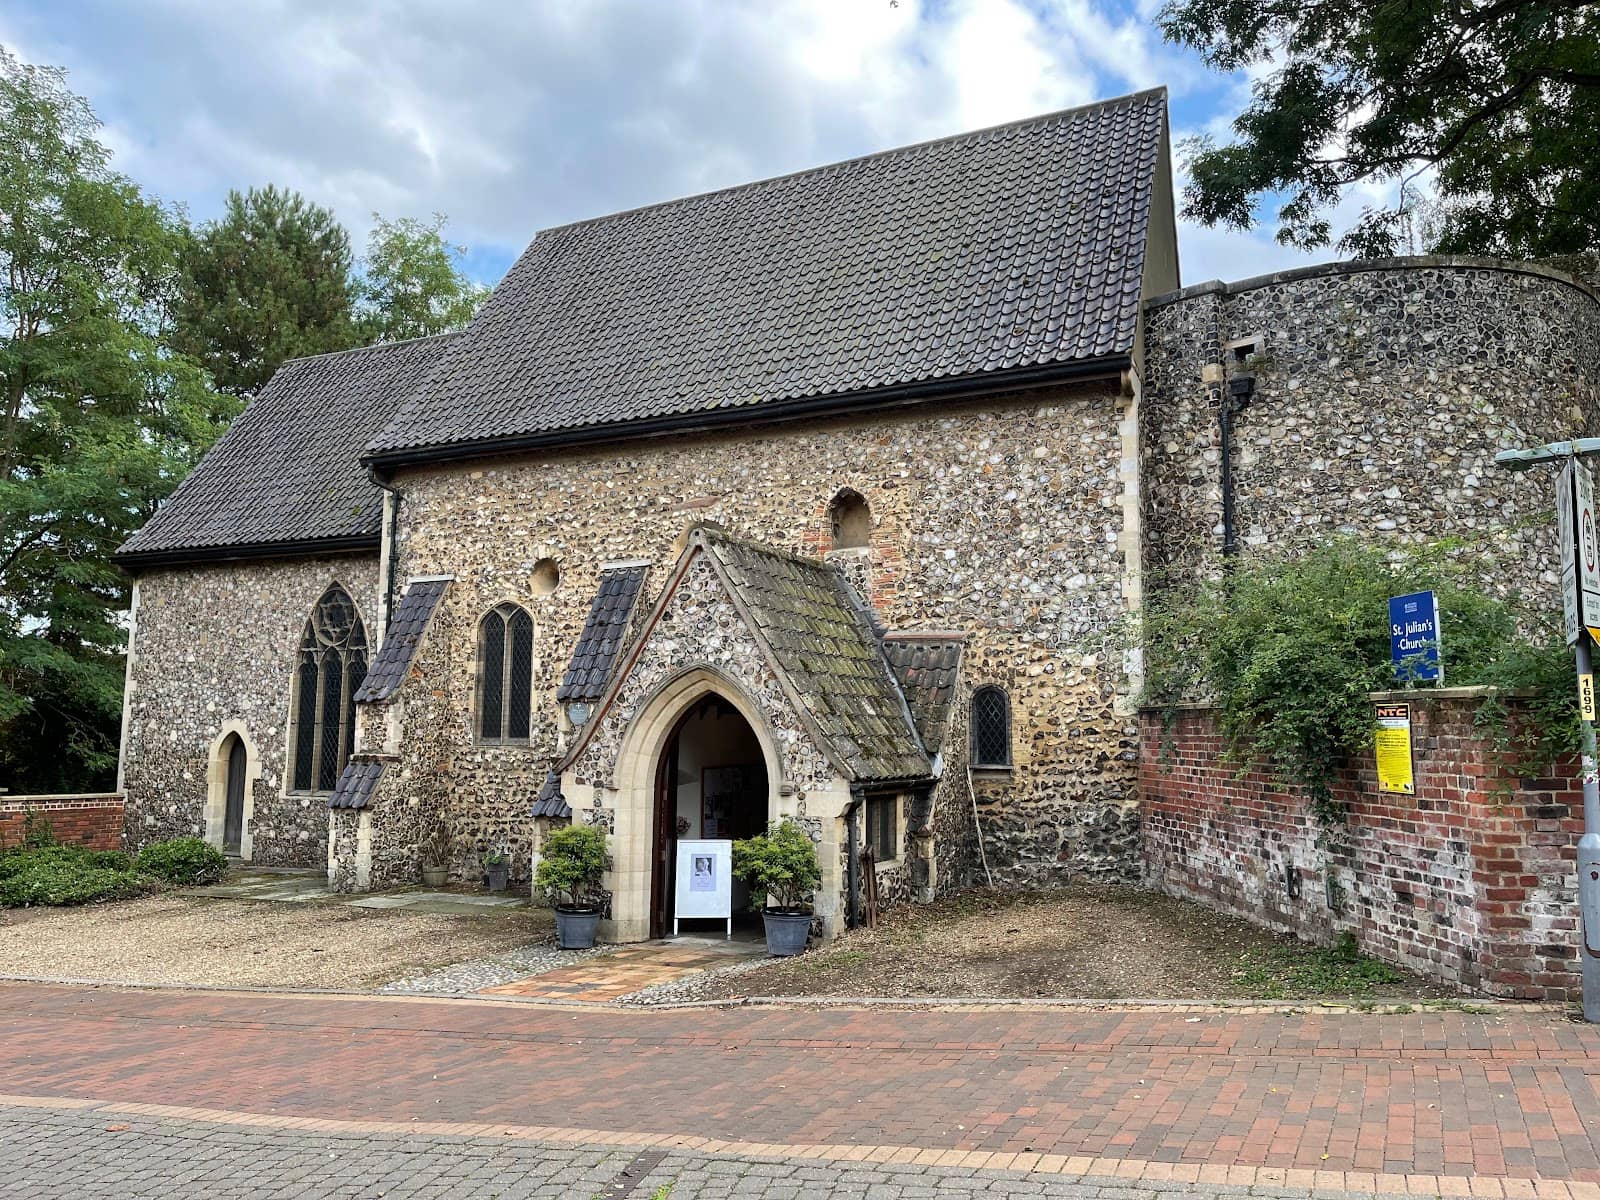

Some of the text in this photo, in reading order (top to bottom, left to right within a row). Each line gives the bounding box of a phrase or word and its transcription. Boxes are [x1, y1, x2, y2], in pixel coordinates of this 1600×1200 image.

[1392, 618, 1433, 637] St. Julian's
[1583, 678, 1592, 714] 1699
[1377, 708, 1407, 717] NTC
